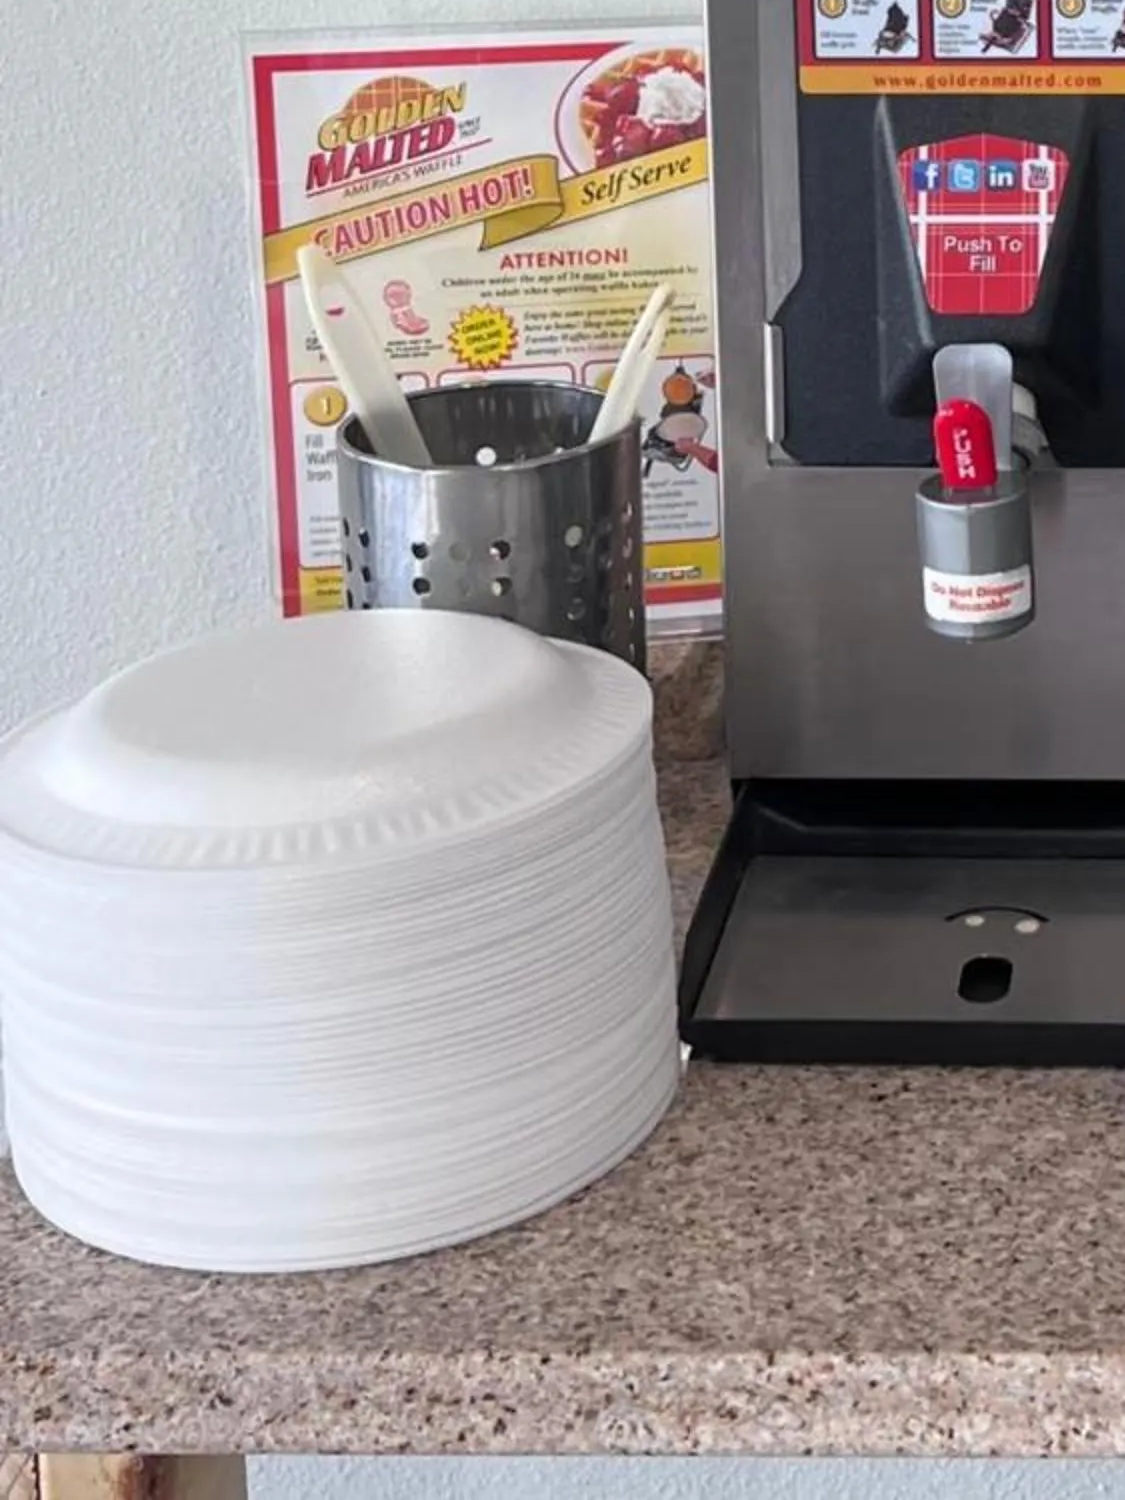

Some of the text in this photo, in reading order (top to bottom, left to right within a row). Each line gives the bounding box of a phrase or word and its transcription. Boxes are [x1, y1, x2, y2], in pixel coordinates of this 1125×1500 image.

[873, 71, 1102, 90] www.goldenmalted.com
[318, 80, 467, 152] GOLDEN
[306, 116, 456, 191] MALTED
[344, 156, 462, 197] AMERICA'S WAFFLE
[581, 156, 691, 205] Self Serve
[989, 165, 1014, 187] in
[459, 167, 532, 213] HOT!
[944, 236, 1023, 252] Push To
[500, 248, 628, 269] ATTENTION!
[969, 255, 996, 272] Fill
[305, 434, 324, 446] Fill
[306, 452, 337, 466] Waff
[306, 470, 332, 482] Iron
